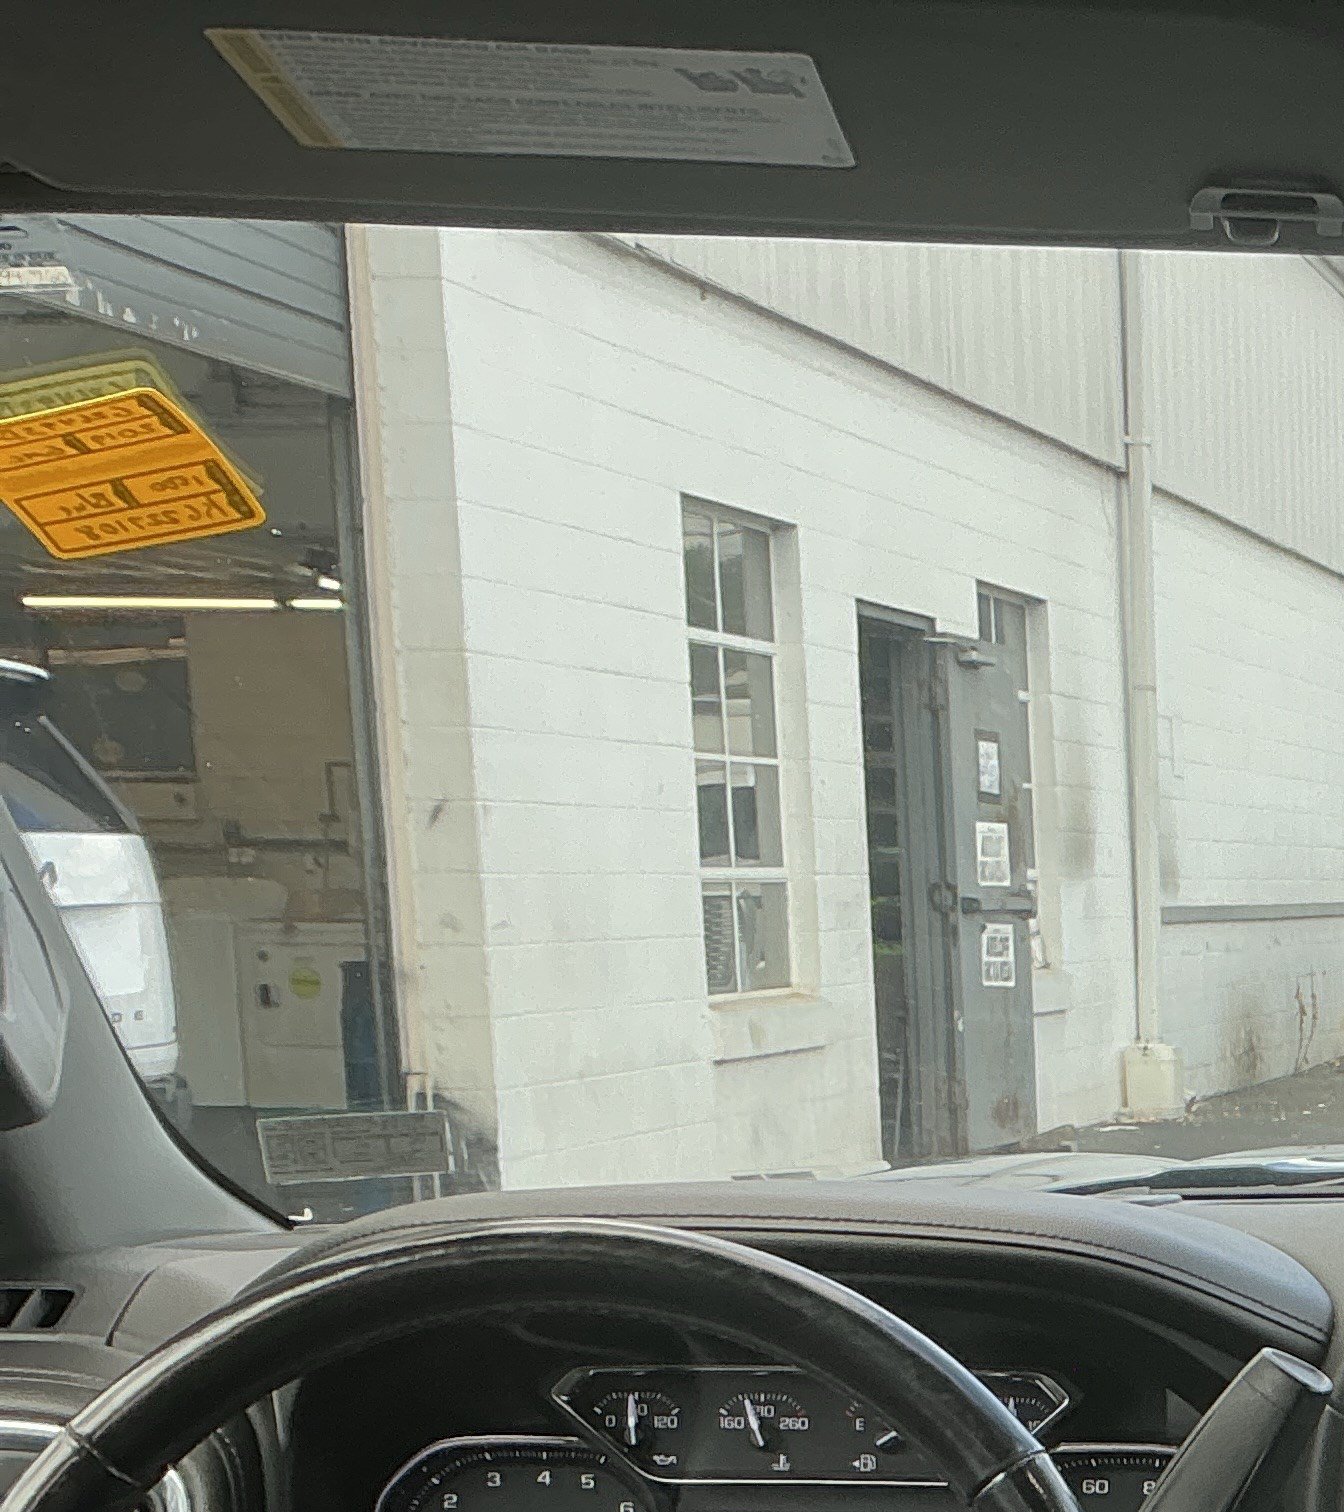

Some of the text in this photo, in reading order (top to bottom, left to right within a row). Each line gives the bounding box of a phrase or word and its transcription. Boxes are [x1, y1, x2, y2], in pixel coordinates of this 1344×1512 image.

[605, 1416, 616, 1428] 0
[654, 1417, 678, 1429] 120
[719, 1416, 745, 1430] 160
[779, 1417, 808, 1431] 260
[855, 1418, 865, 1431] E
[486, 1472, 501, 1488] 3
[536, 1470, 551, 1486] 4
[580, 1474, 595, 1489] 5
[1082, 1479, 1109, 1494] 60
[443, 1494, 458, 1509] 2
